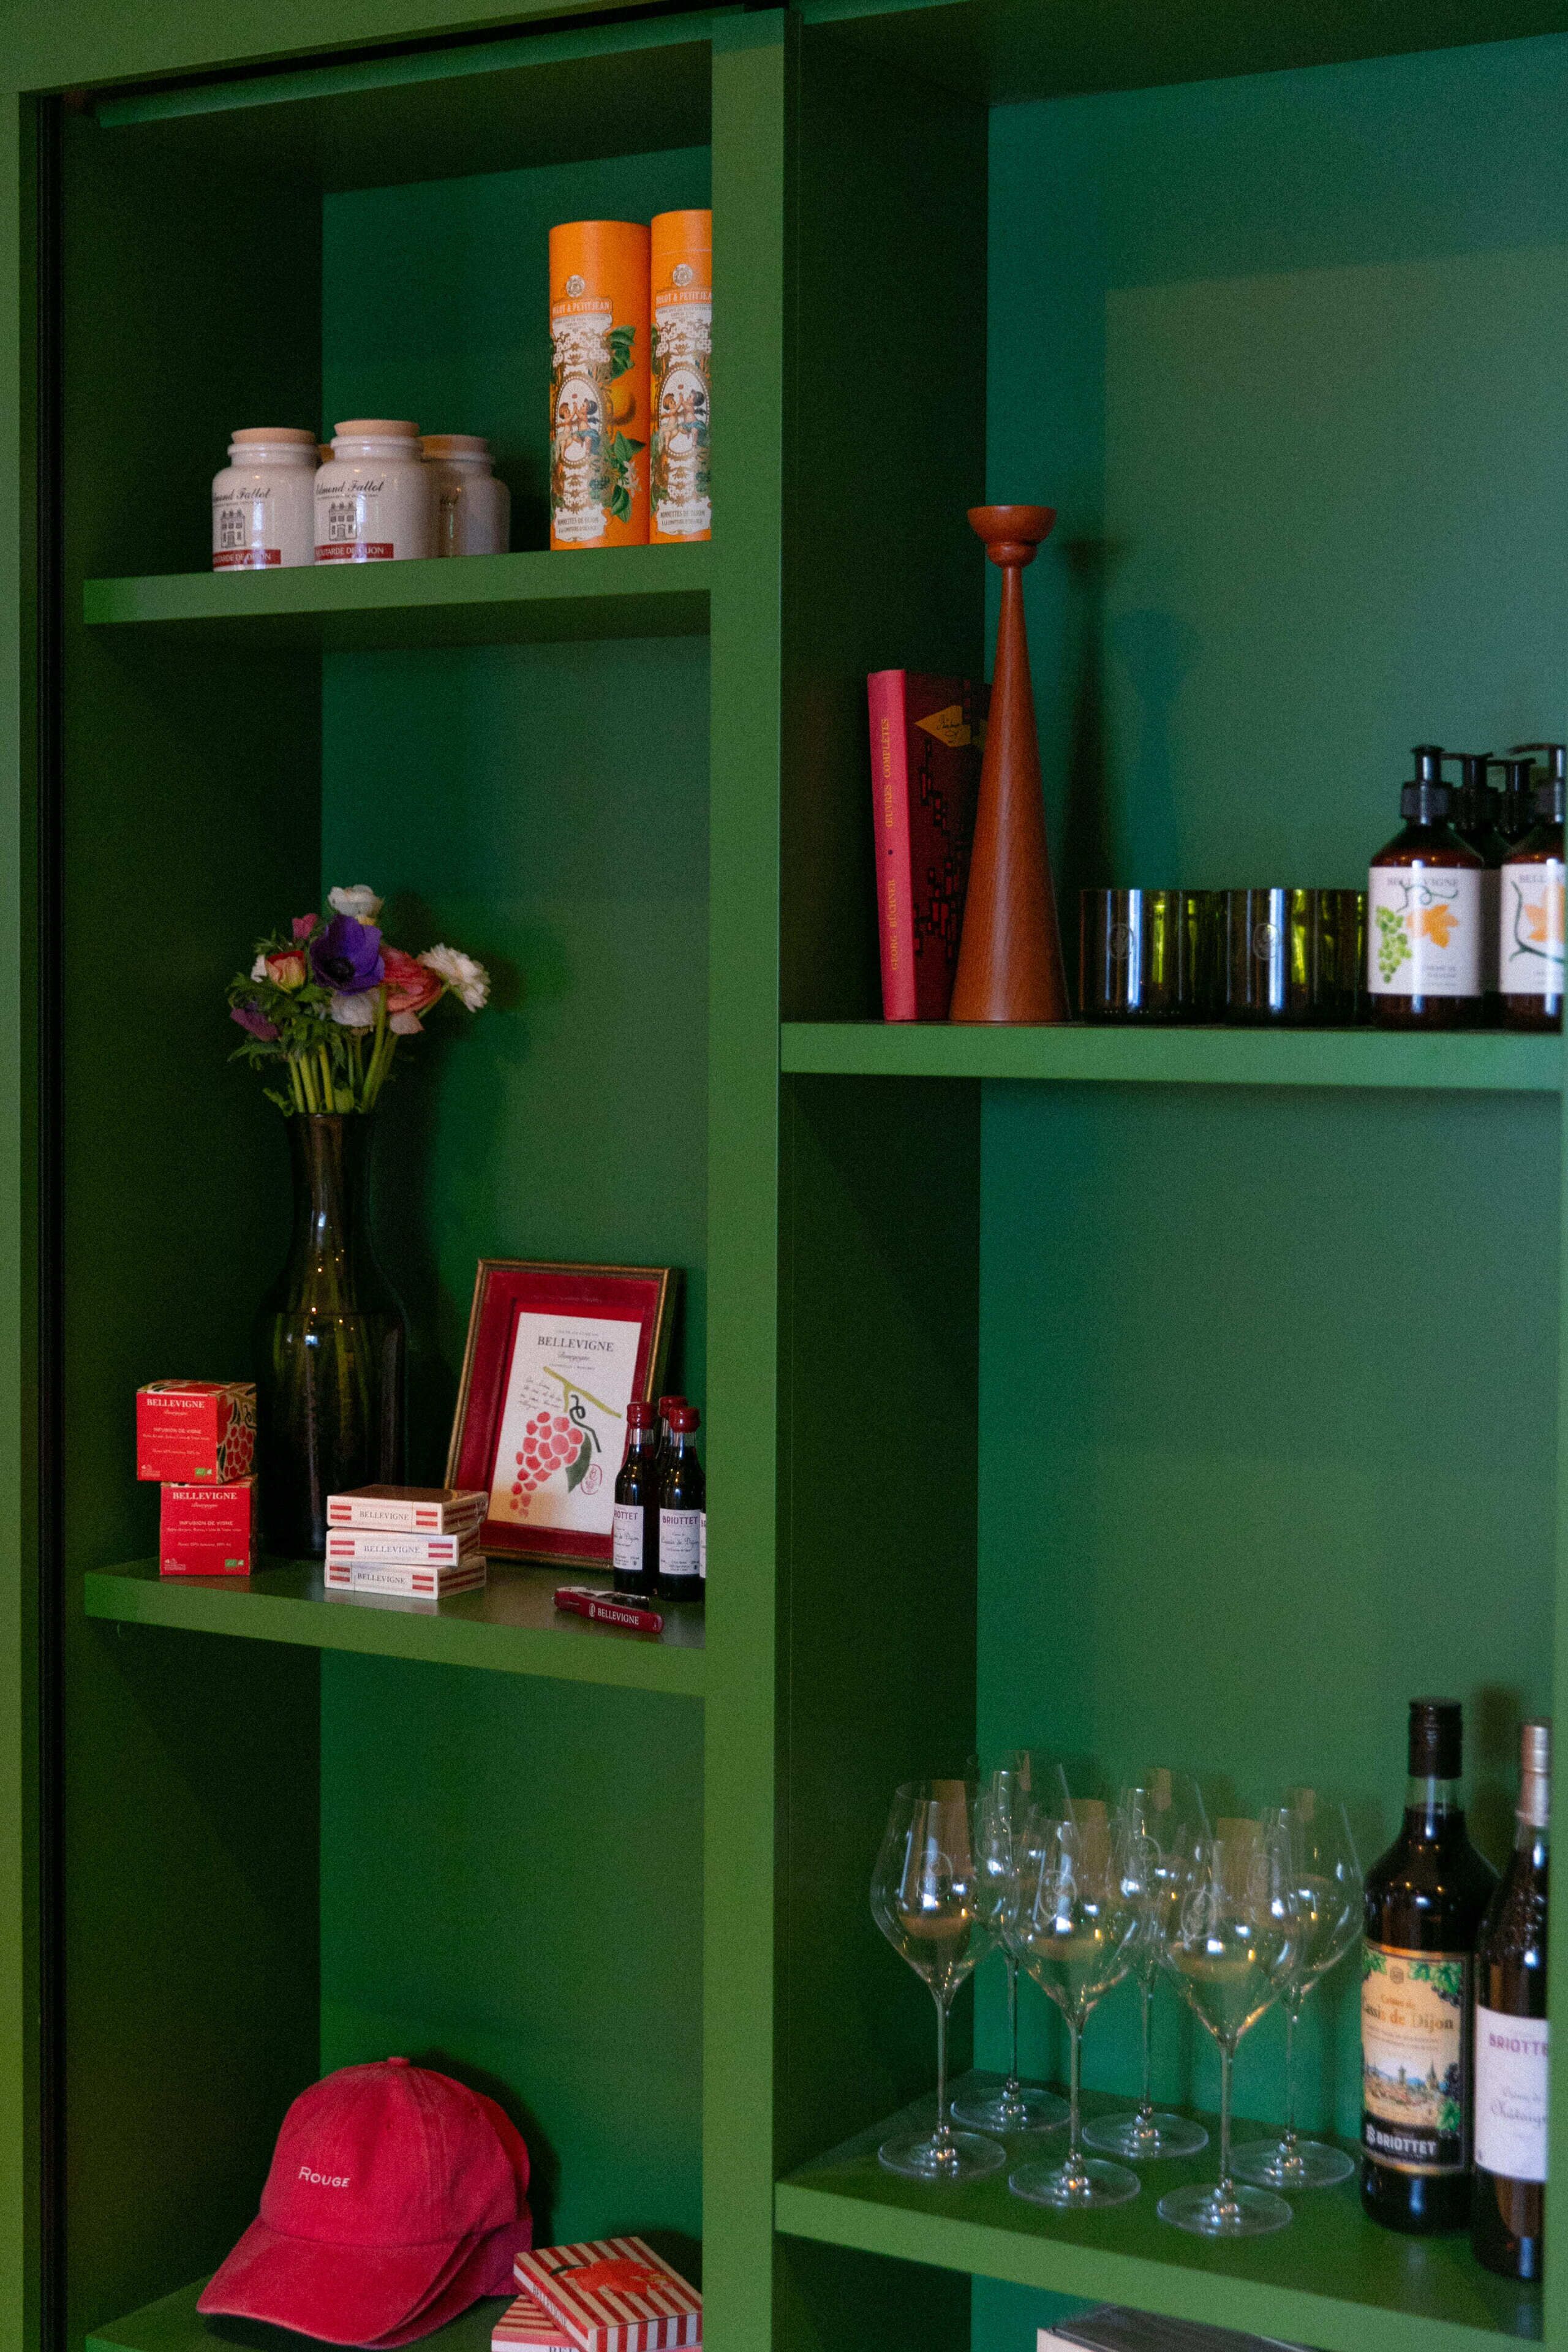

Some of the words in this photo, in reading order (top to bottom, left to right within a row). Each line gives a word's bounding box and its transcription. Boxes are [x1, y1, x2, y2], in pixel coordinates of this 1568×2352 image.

[679, 291, 712, 301] PETITJEA
[347, 480, 384, 492] Fallot
[538, 1336, 614, 1352] BELLEVIGNE
[147, 1398, 205, 1409] BELLEVIGNE
[173, 1491, 237, 1500] BELLEVIGNE
[360, 1510, 410, 1521] BELLEVIGNE
[364, 1545, 421, 1555] BELLEVIGNE
[358, 1573, 407, 1585] BELLEVIGNE
[598, 1607, 640, 1626] BELLEVIGNE
[1488, 2032, 1548, 2057] BRIOTTE
[1376, 2130, 1437, 2156] BRIOTTET
